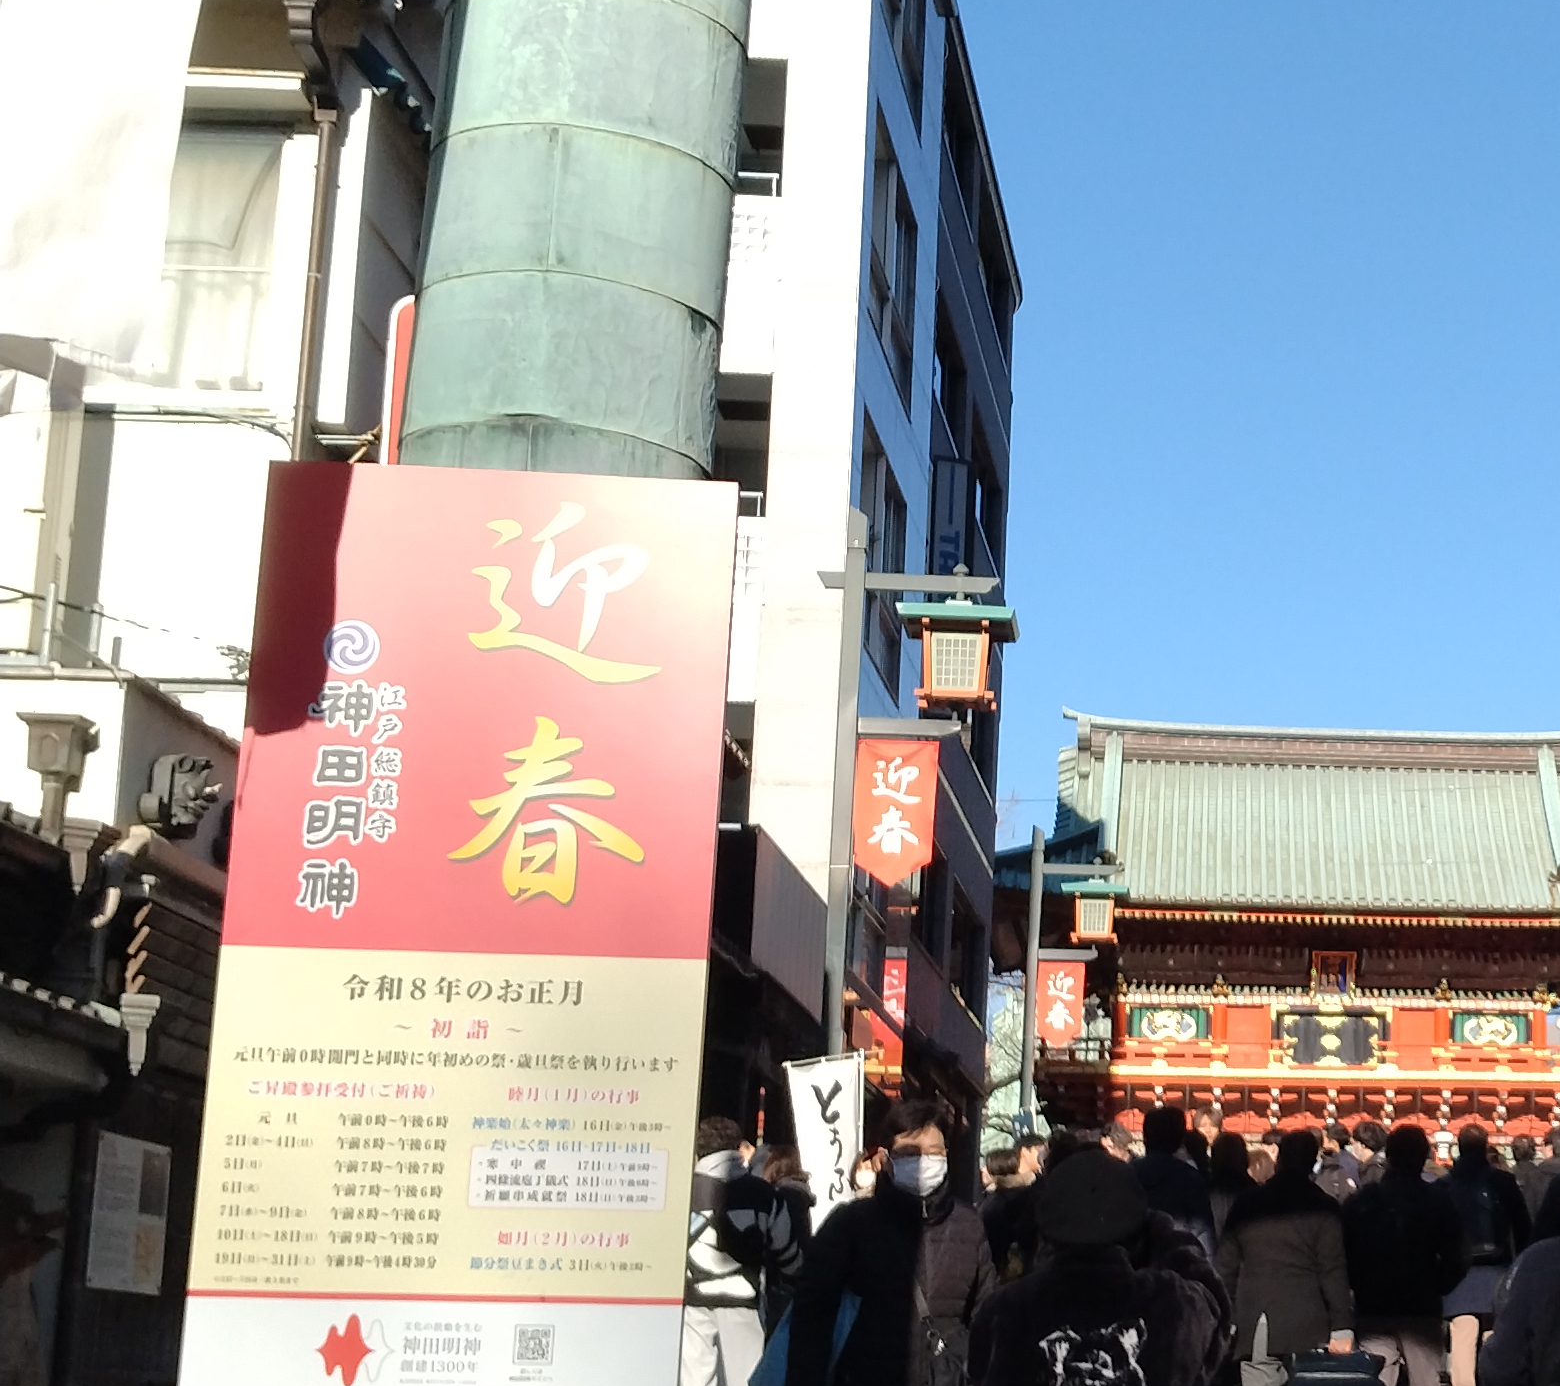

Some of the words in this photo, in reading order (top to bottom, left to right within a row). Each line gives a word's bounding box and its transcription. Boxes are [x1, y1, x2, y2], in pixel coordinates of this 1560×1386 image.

[367, 684, 407, 841] 江戸総鎮守
[447, 502, 662, 906] 迎春
[296, 680, 375, 918] 神田明神
[867, 758, 922, 854] 迎春
[342, 974, 585, 1007] 令和8年のお正月
[1045, 970, 1076, 1030] 迎春
